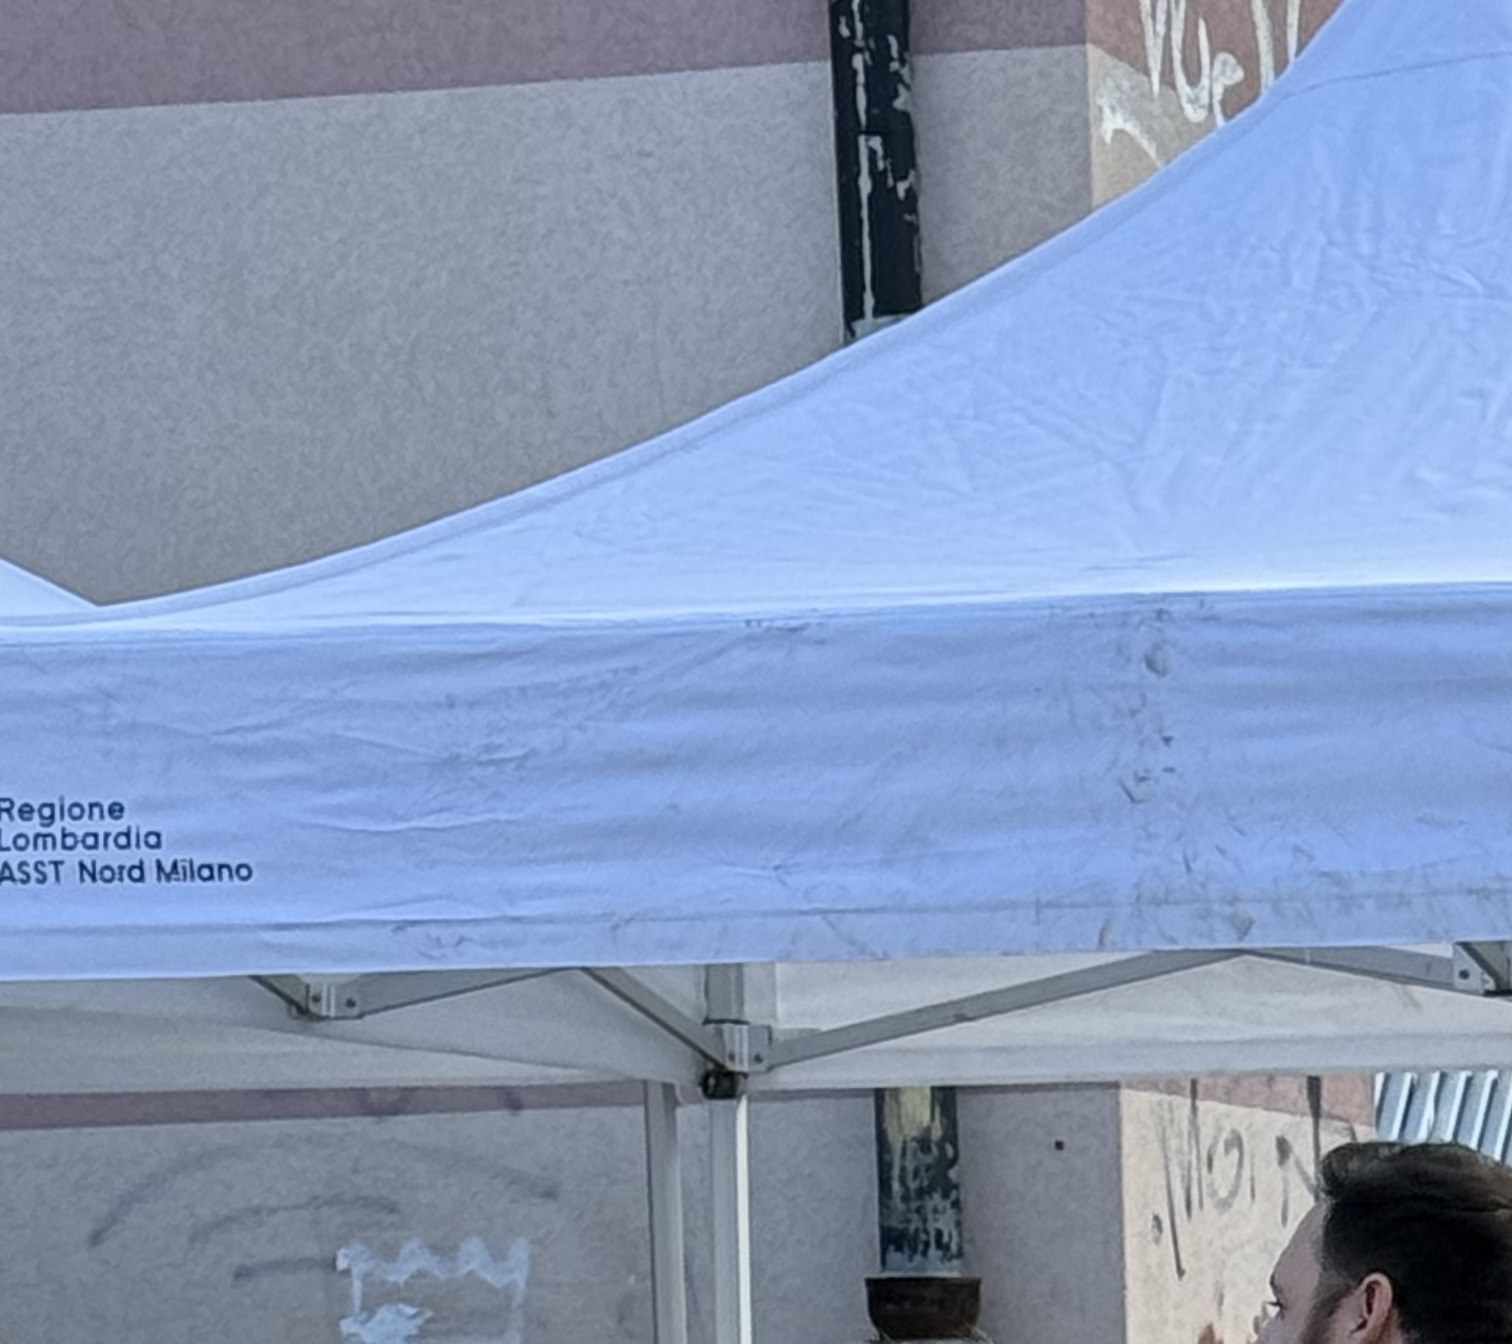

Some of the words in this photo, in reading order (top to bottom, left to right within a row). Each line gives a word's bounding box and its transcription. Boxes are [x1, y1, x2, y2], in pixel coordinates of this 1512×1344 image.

[0, 796, 125, 828] Regione
[0, 825, 163, 851] Lombardia
[0, 860, 65, 885] ASST
[78, 859, 146, 884] Nord
[155, 858, 253, 883] Milano
